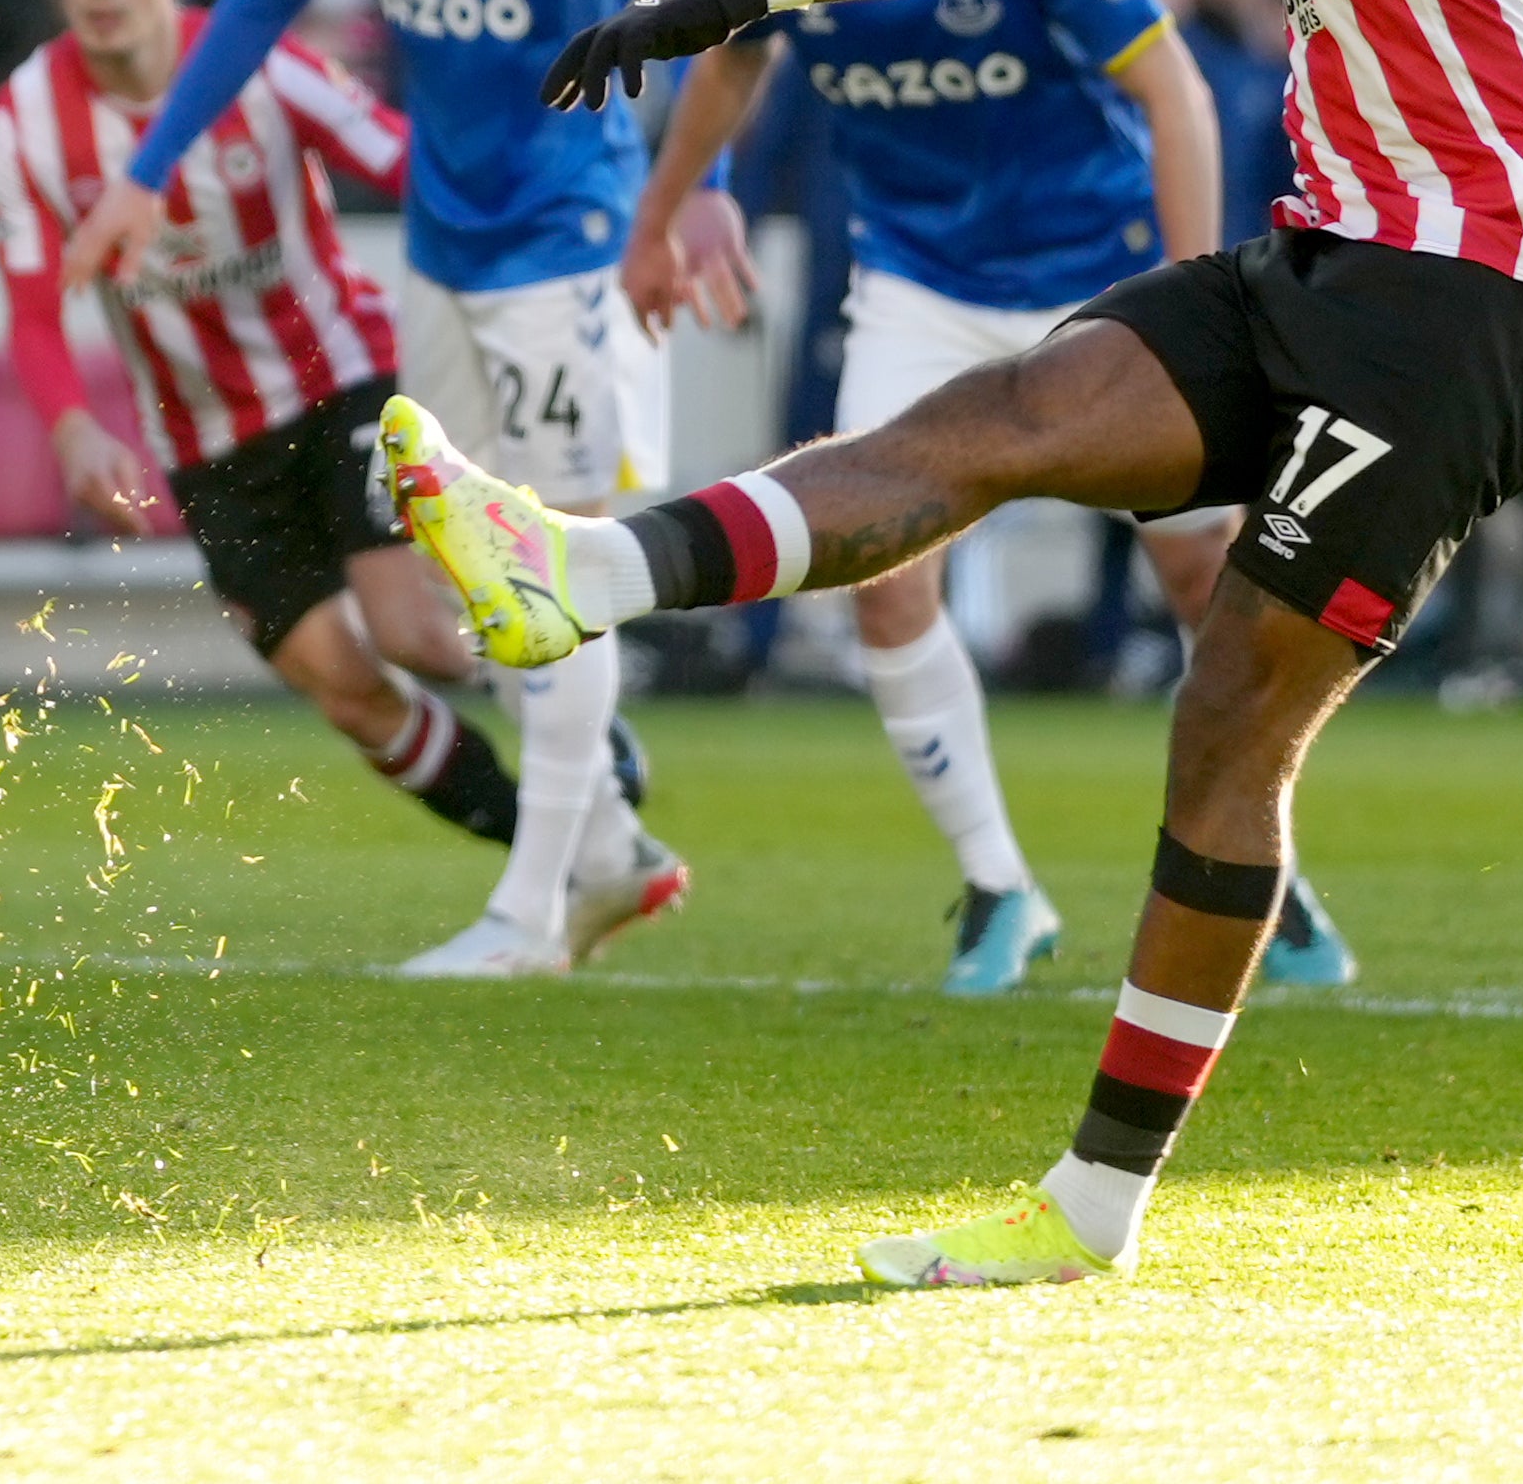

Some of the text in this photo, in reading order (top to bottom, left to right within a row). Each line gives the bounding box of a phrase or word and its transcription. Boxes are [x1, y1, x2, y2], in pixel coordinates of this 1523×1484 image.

[810, 53, 1027, 108] CAZOO
[494, 363, 582, 438] 24
[1268, 405, 1394, 518] 17
